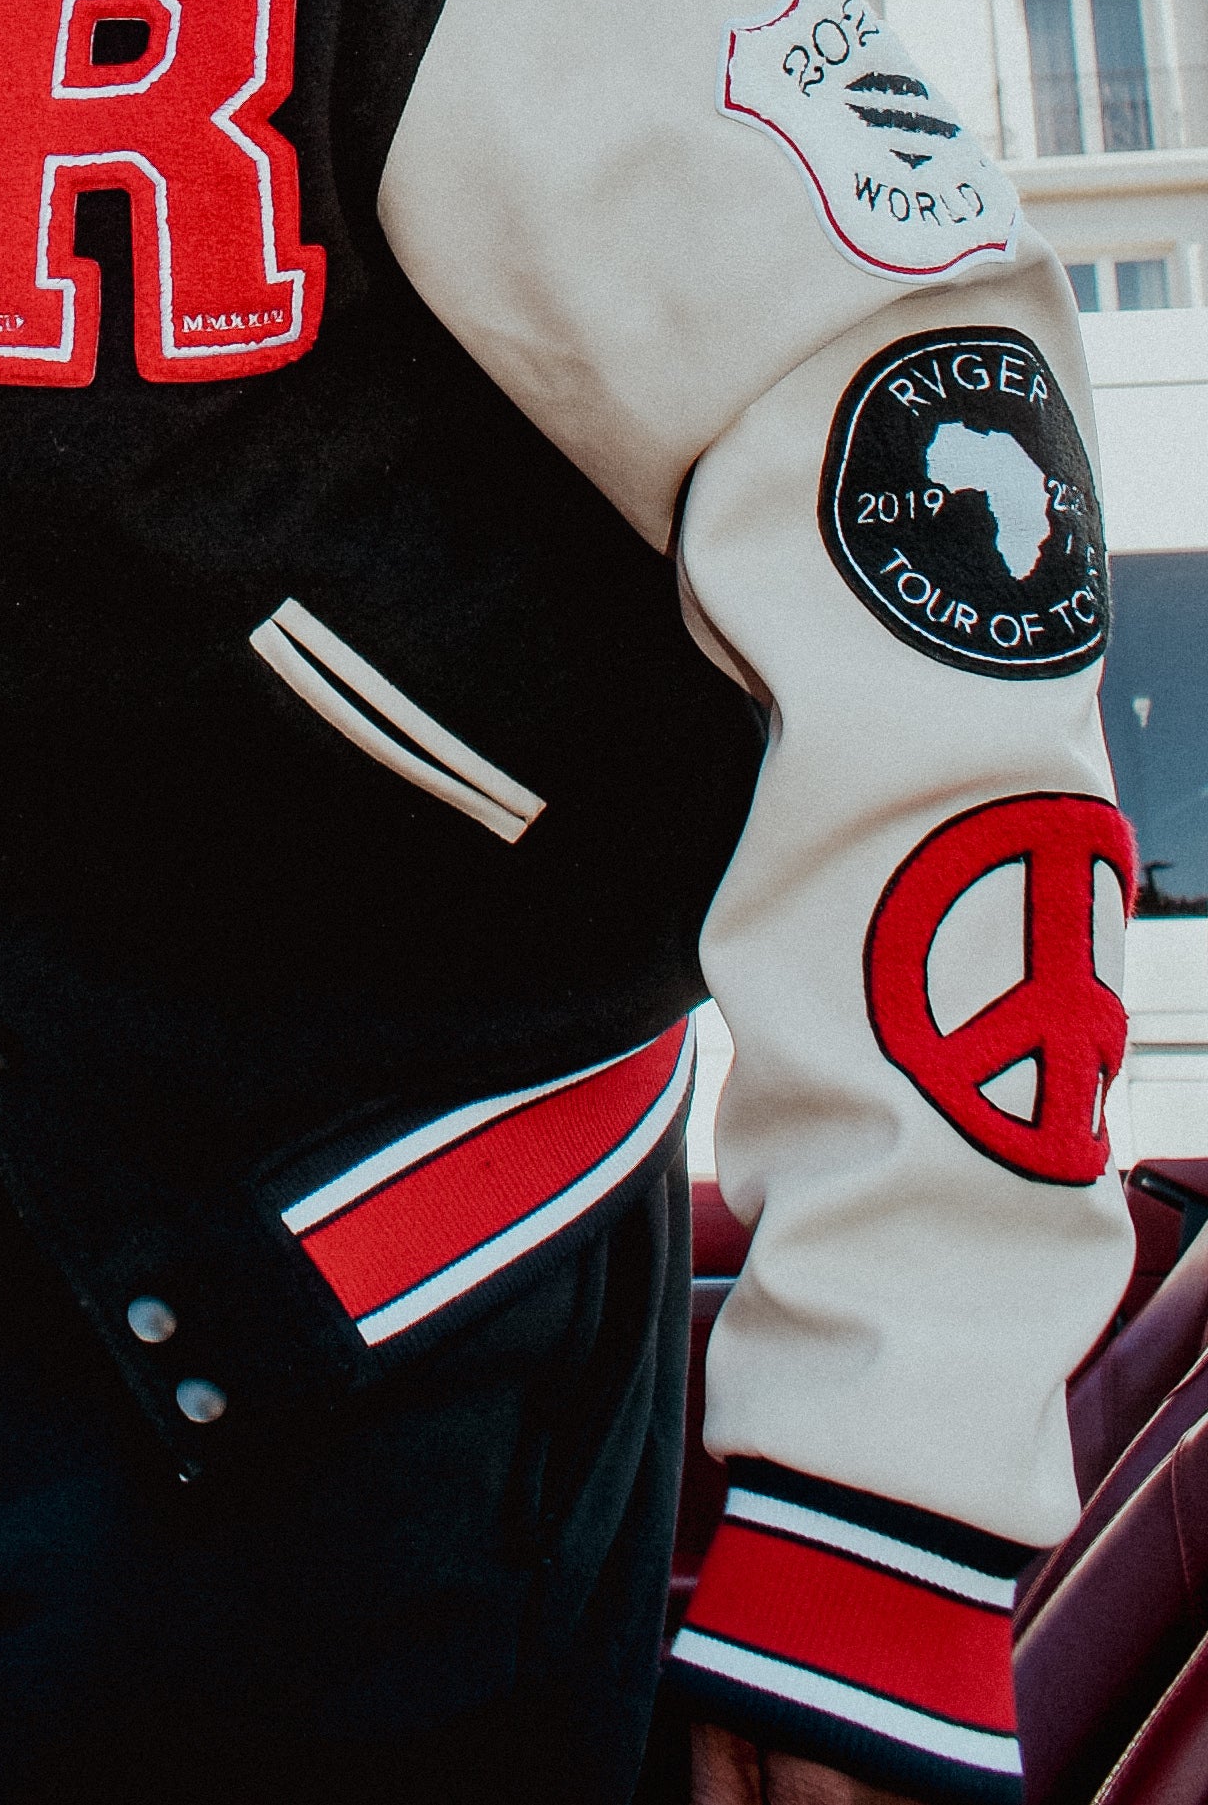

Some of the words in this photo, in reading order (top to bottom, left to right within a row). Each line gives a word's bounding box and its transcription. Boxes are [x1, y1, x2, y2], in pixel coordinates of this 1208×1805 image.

[854, 173, 985, 227] WORLD
[857, 488, 944, 524] 2019
[880, 548, 979, 634] TOUR
[990, 612, 1044, 647] OF
